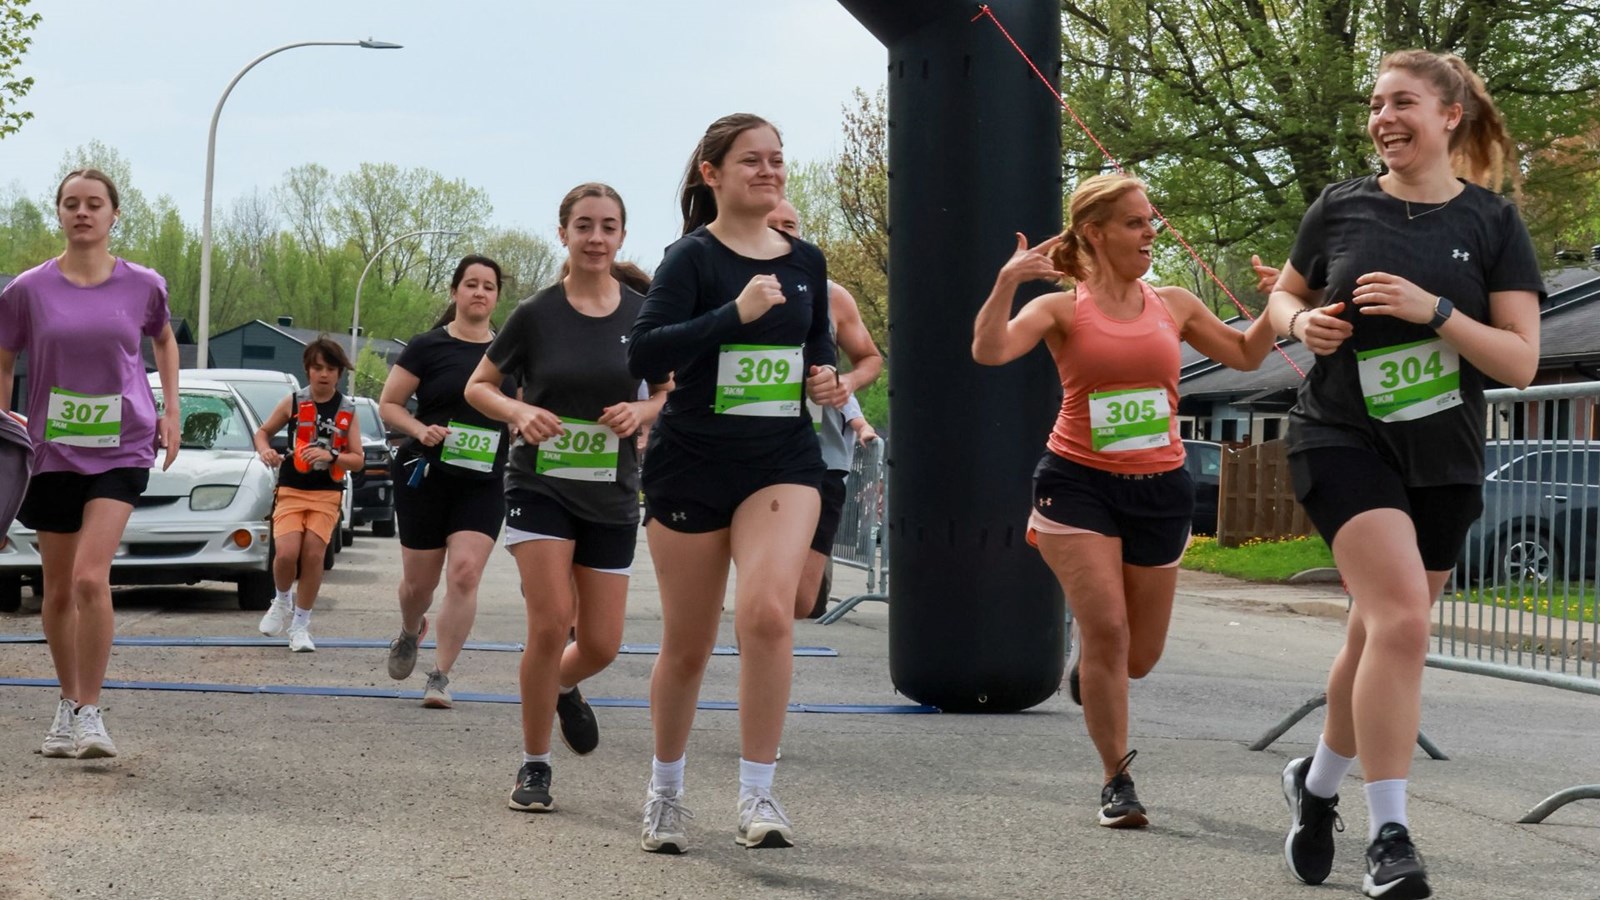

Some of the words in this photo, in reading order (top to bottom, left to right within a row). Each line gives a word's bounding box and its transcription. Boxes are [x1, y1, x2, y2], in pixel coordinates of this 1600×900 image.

[736, 358, 790, 384] 309
[1380, 351, 1444, 388] 304
[723, 387, 744, 395] 3KM
[1372, 394, 1394, 405] 3KM
[61, 401, 109, 423] 307
[1106, 400, 1156, 424] 305
[52, 420, 67, 429] 3KM
[455, 432, 491, 452] 303
[554, 428, 606, 454] 308
[543, 451, 561, 460] 3KM
